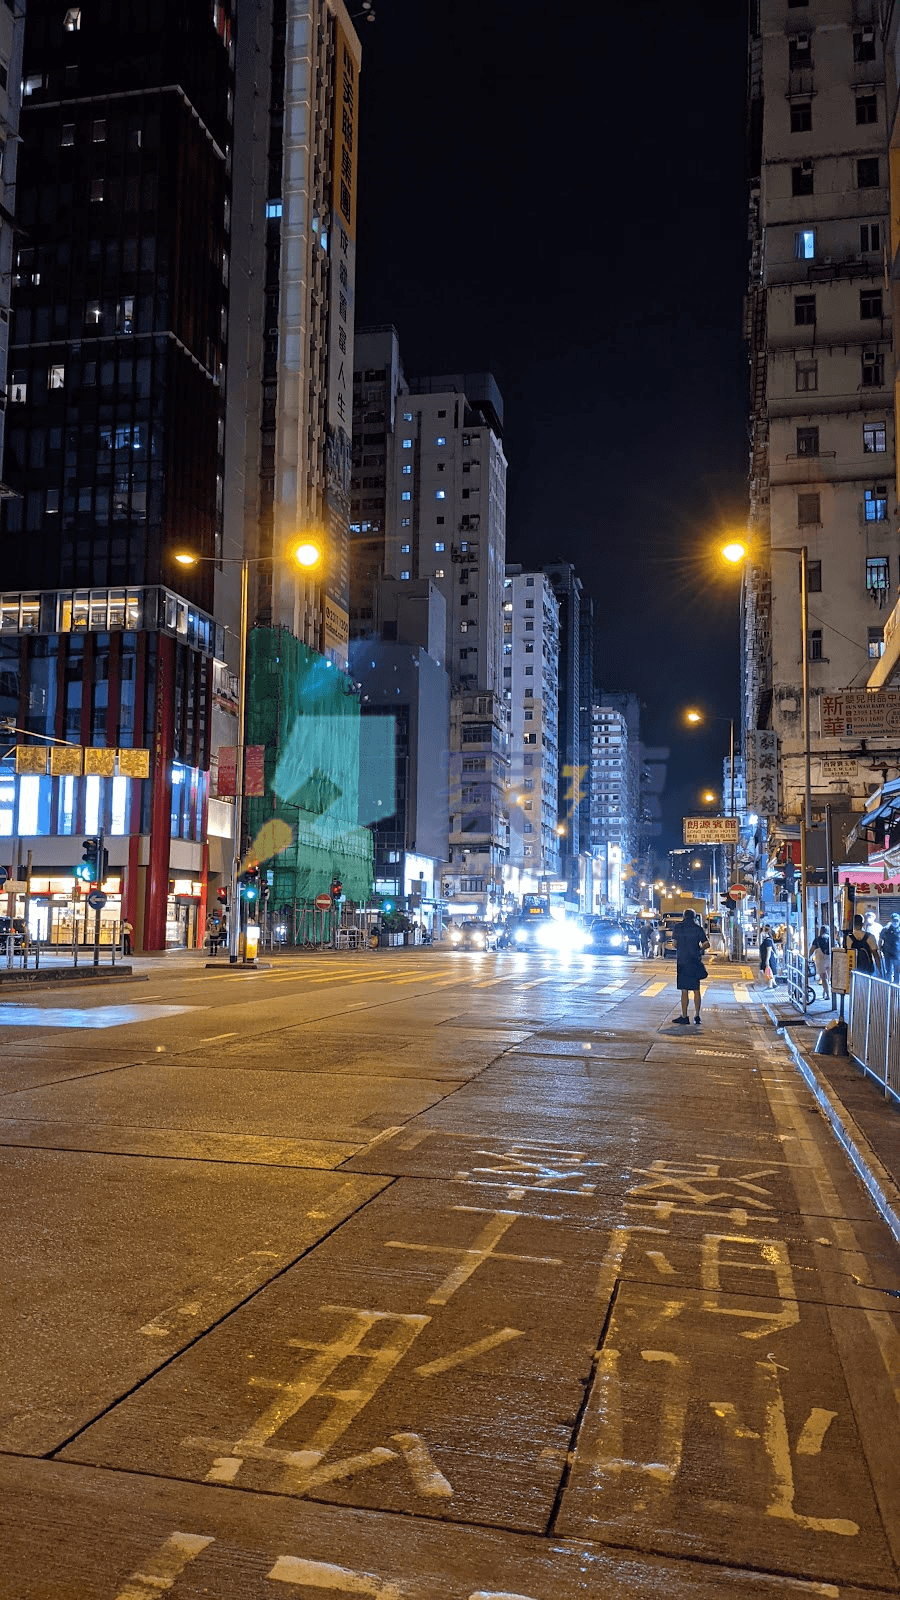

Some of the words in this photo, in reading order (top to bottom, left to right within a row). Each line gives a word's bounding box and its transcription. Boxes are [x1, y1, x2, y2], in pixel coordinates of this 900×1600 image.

[845, 694, 900, 704] 嬰兒用品中
[823, 695, 845, 736] 新華
[687, 819, 737, 829] 朗源賓館
